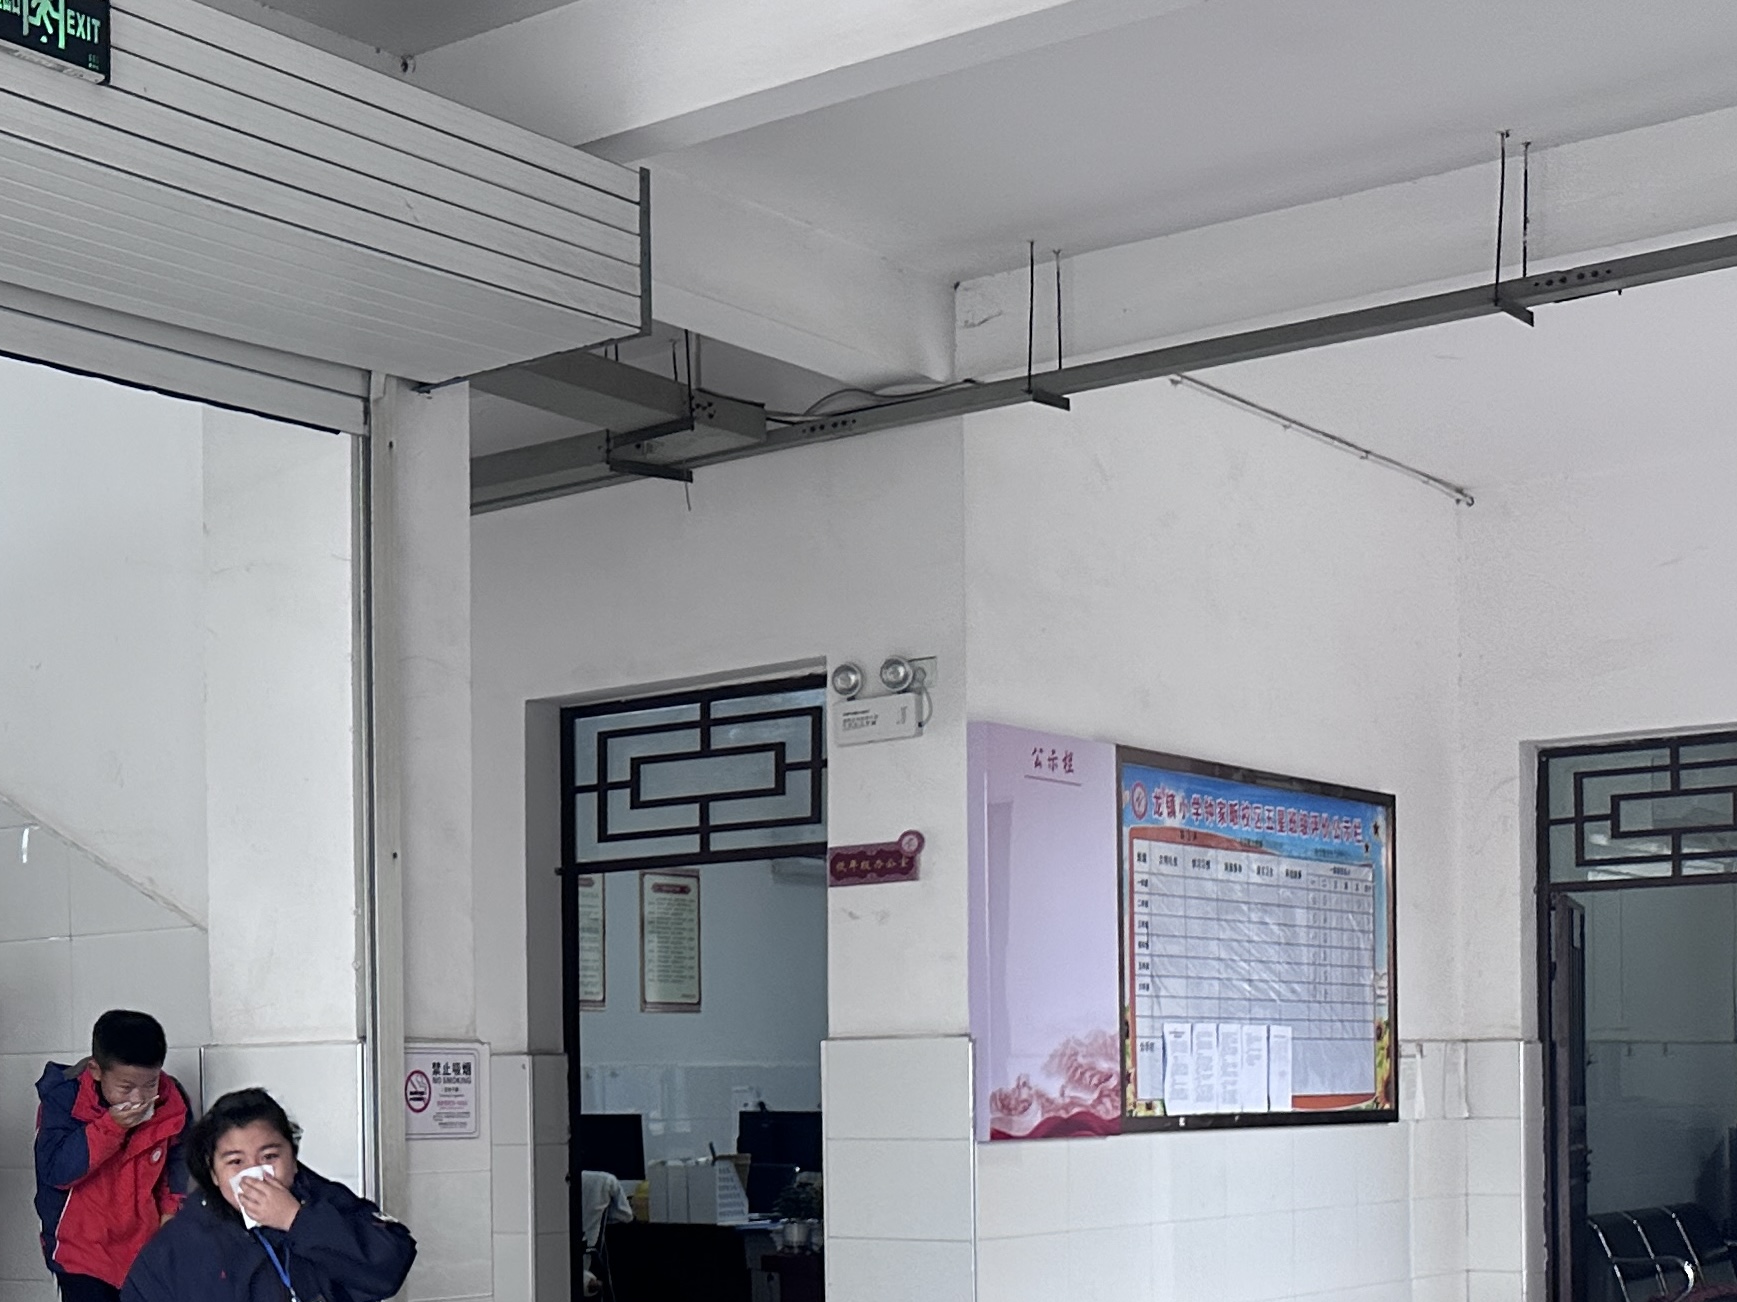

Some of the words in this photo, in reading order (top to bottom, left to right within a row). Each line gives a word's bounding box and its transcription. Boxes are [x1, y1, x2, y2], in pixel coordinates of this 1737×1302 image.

[67, 9, 101, 44] EXIT
[1031, 747, 1074, 773] 公示栏
[432, 1062, 472, 1076] 禁止吸烟
[432, 1076, 442, 1084] NO
[443, 1076, 472, 1084] SMOKING
